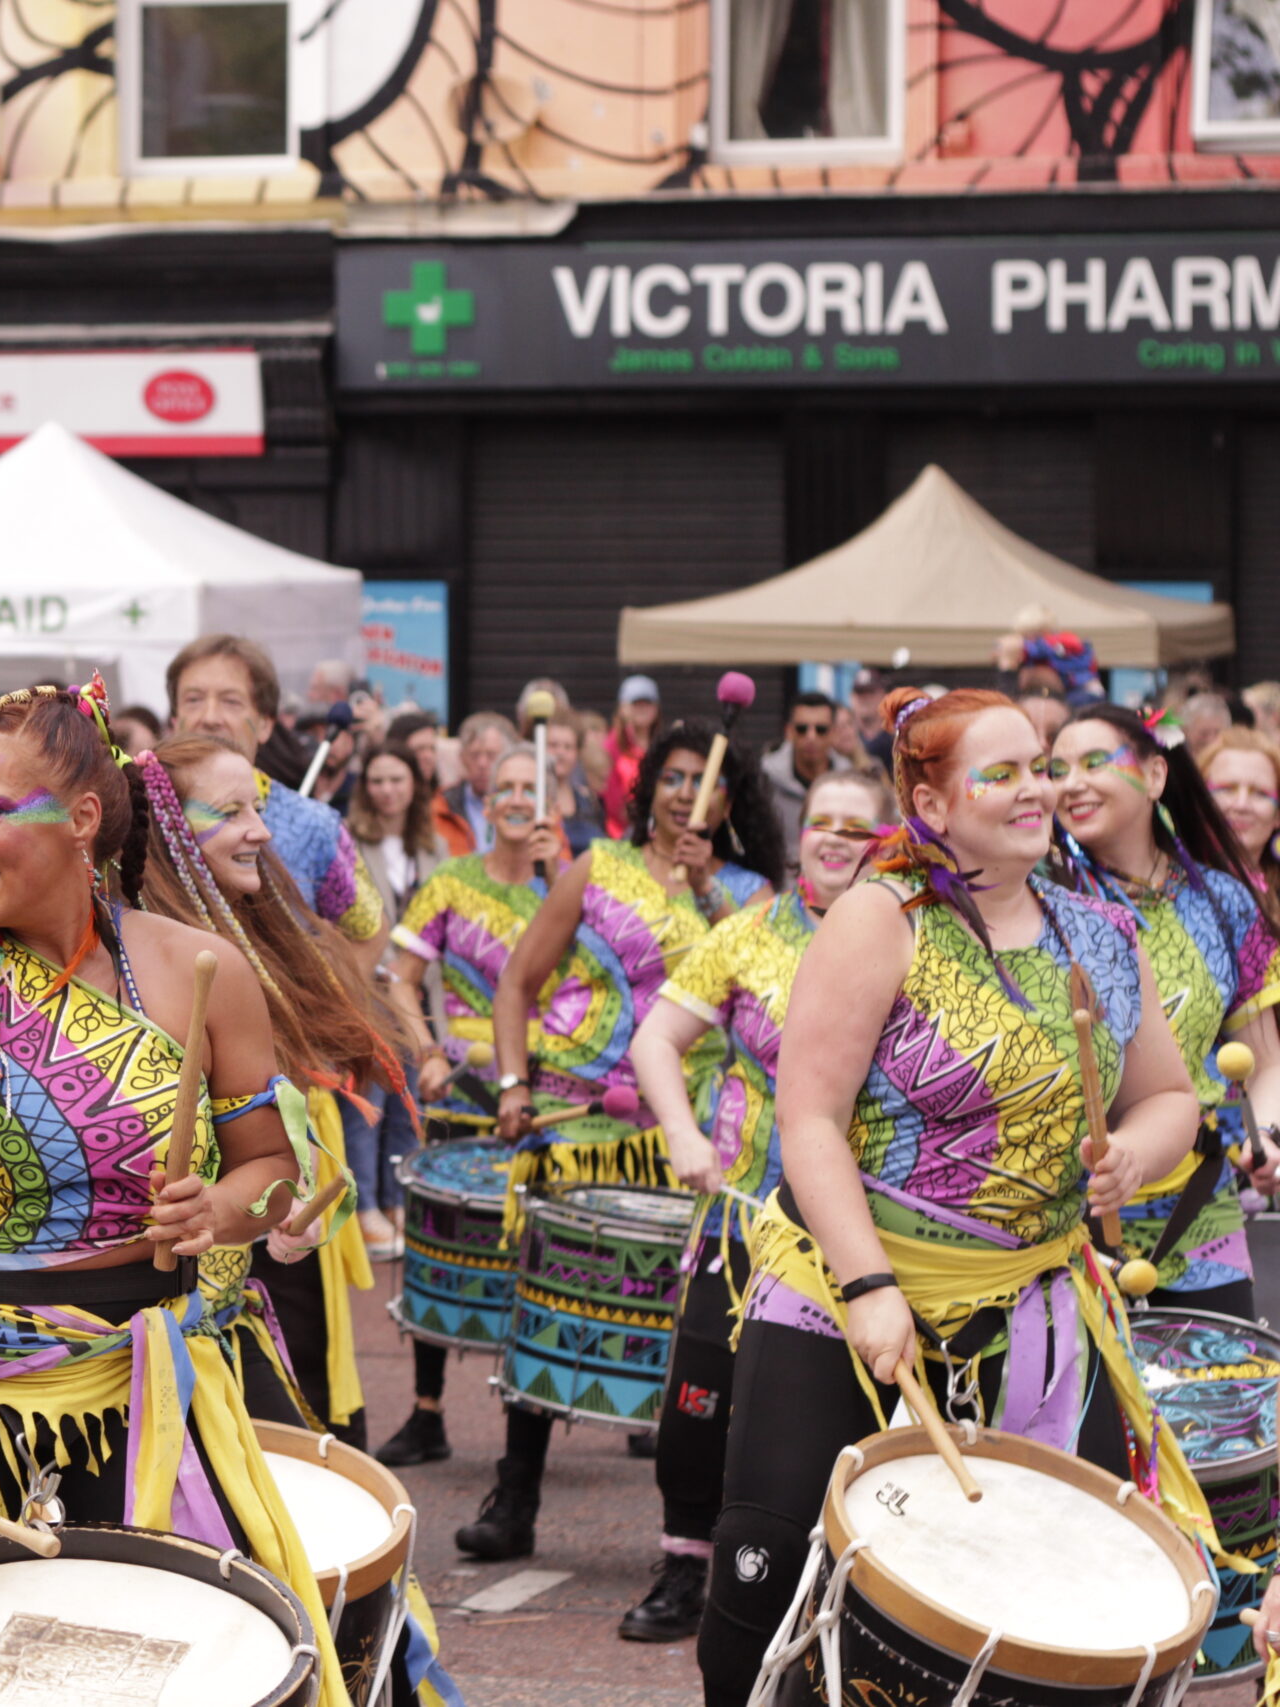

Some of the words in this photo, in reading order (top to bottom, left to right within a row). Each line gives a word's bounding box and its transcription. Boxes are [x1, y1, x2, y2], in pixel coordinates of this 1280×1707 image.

[551, 261, 949, 338] VICTORIA
[991, 255, 1280, 334] PHARM
[611, 346, 694, 373] James
[832, 341, 901, 370] Sons
[1137, 339, 1226, 374] Caring
